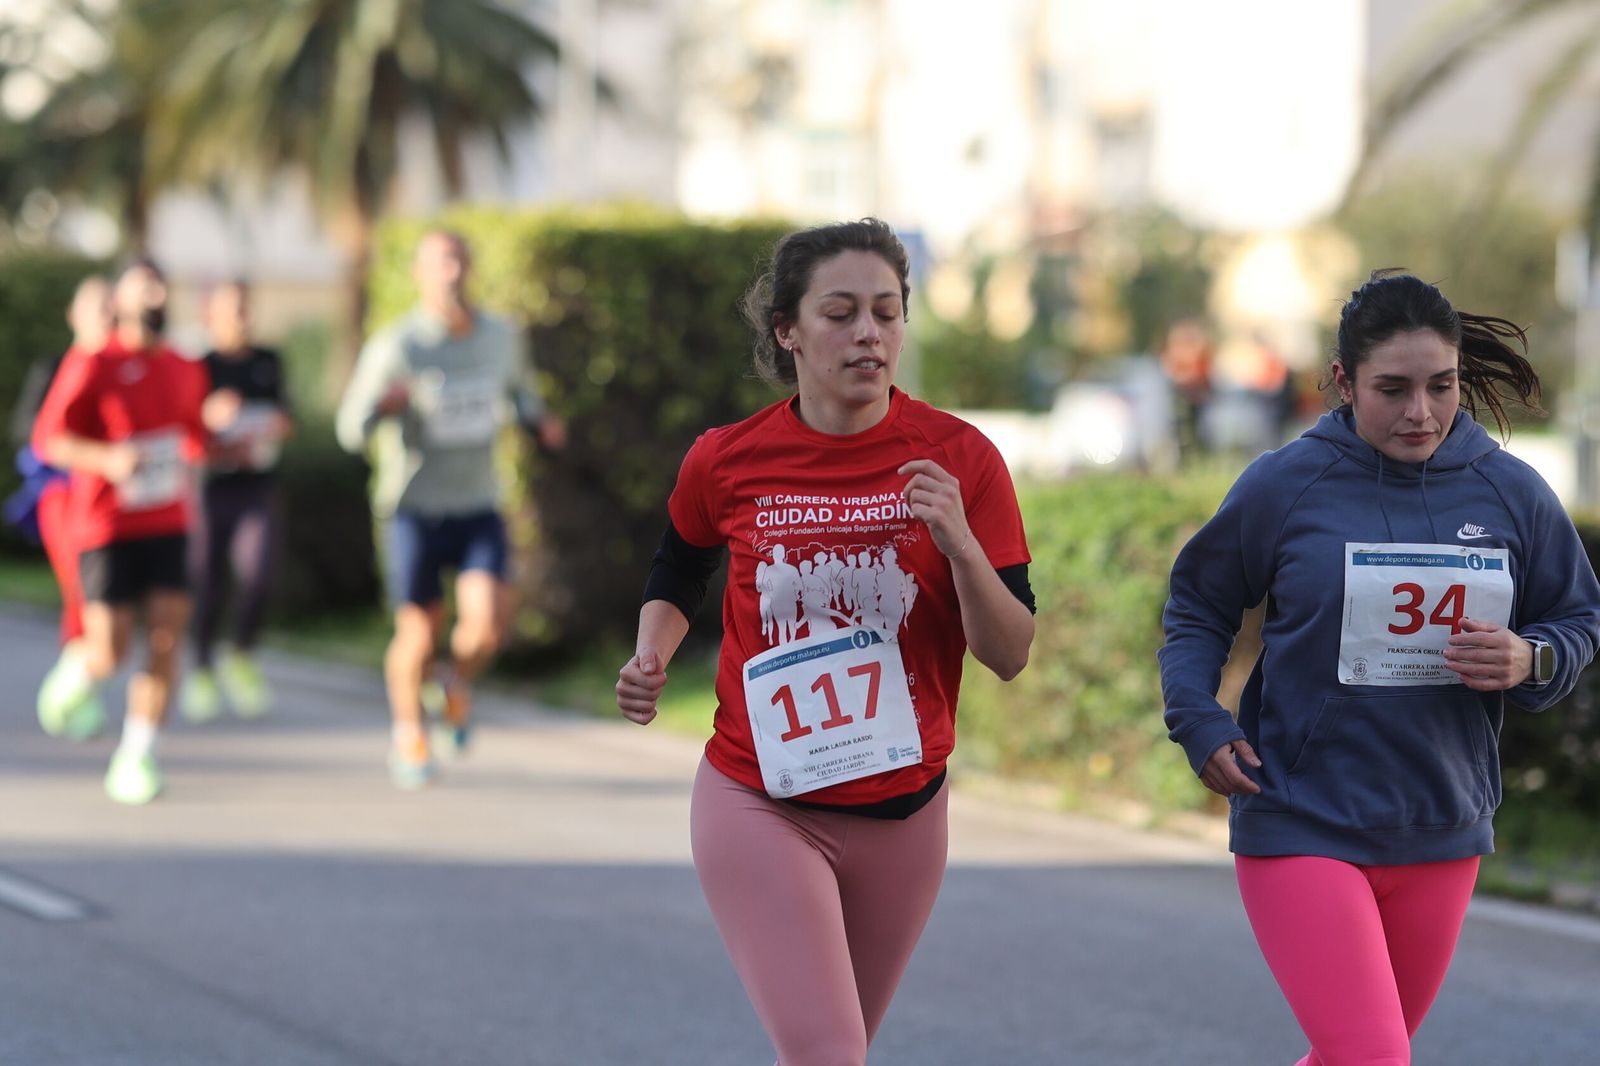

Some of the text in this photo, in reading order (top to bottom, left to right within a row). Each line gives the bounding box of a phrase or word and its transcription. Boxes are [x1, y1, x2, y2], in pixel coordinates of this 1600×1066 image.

[755, 496, 773, 508] VIII
[775, 494, 839, 505] CARRERA
[842, 492, 898, 506] URBANA
[755, 499, 915, 528] CIUDAD JARDÍN
[763, 529, 788, 538] Colegio
[789, 526, 825, 535] Fundación
[826, 524, 852, 534] Unicaja
[854, 524, 883, 533] Sagrada
[1462, 522, 1485, 536] NIKE
[1366, 556, 1445, 565] www.deporte.malaga.eu
[1387, 582, 1467, 636] 34
[758, 645, 830, 673] www.deporte.malaga.eu
[1387, 647, 1422, 655] FRANCISCA
[770, 661, 882, 743] 117
[809, 734, 873, 755] MARIA LAURA RANDO
[817, 757, 848, 770] CARRERA
[848, 750, 875, 762] URBANA
[816, 767, 842, 778] CIUDAD
